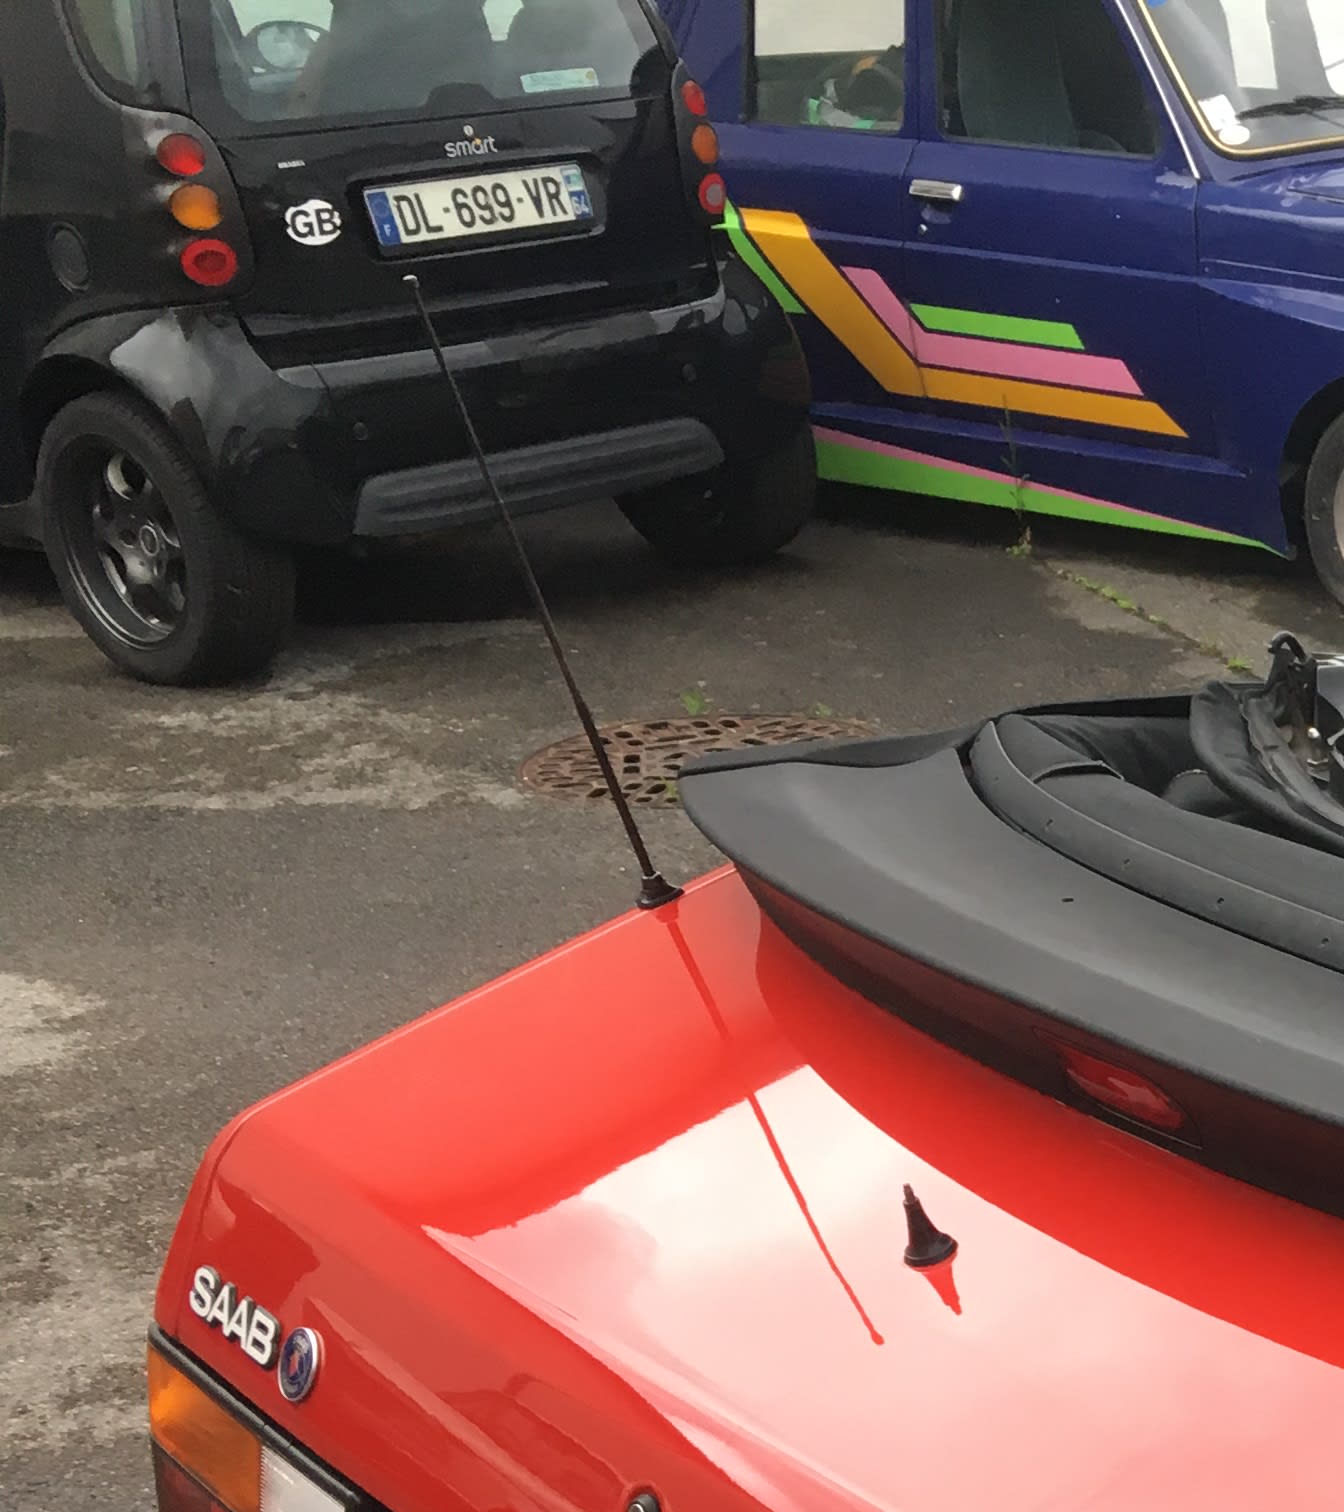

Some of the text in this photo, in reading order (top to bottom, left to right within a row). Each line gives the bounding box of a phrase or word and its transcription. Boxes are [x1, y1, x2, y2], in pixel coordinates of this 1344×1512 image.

[444, 135, 498, 158] smart
[289, 206, 341, 238] GB
[188, 1265, 279, 1367] SAAB
